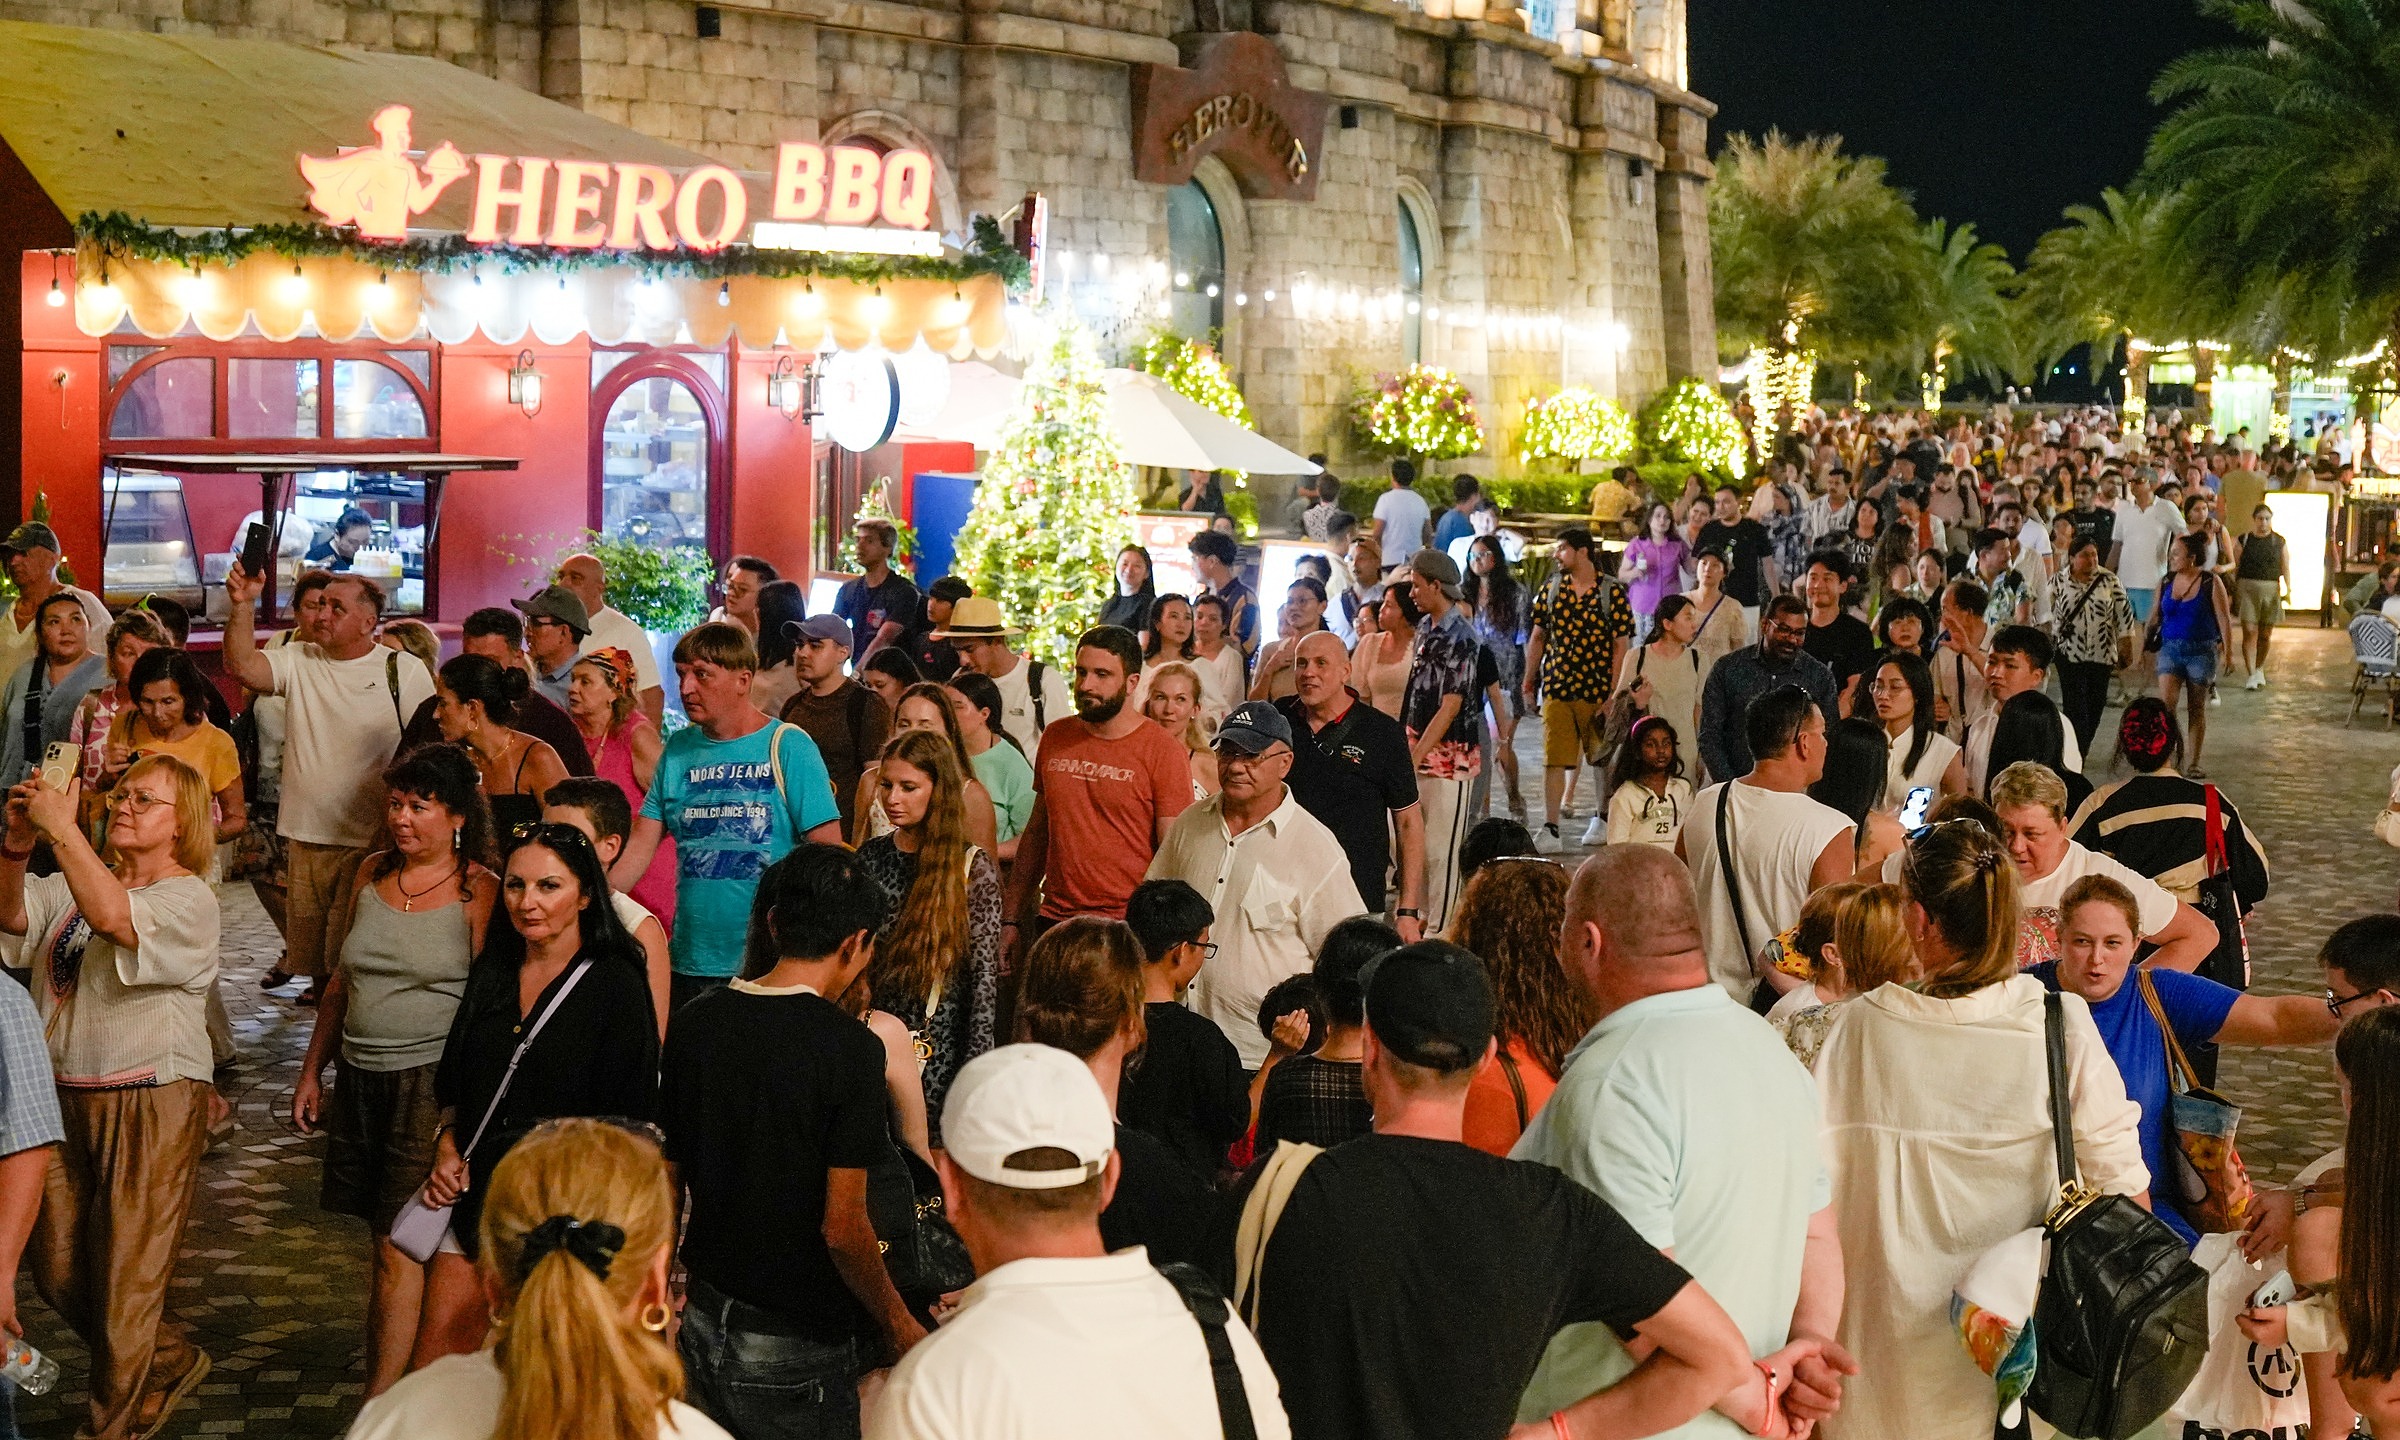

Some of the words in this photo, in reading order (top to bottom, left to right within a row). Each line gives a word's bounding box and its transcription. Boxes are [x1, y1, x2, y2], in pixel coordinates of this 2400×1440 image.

[466, 154, 747, 253] HERO
[773, 142, 934, 230] BBQ
[690, 766, 725, 783] MONS
[729, 763, 771, 779] JEANS
[720, 806, 743, 818] SINCE
[746, 807, 767, 818] 1994
[1656, 822, 1669, 834] 25
